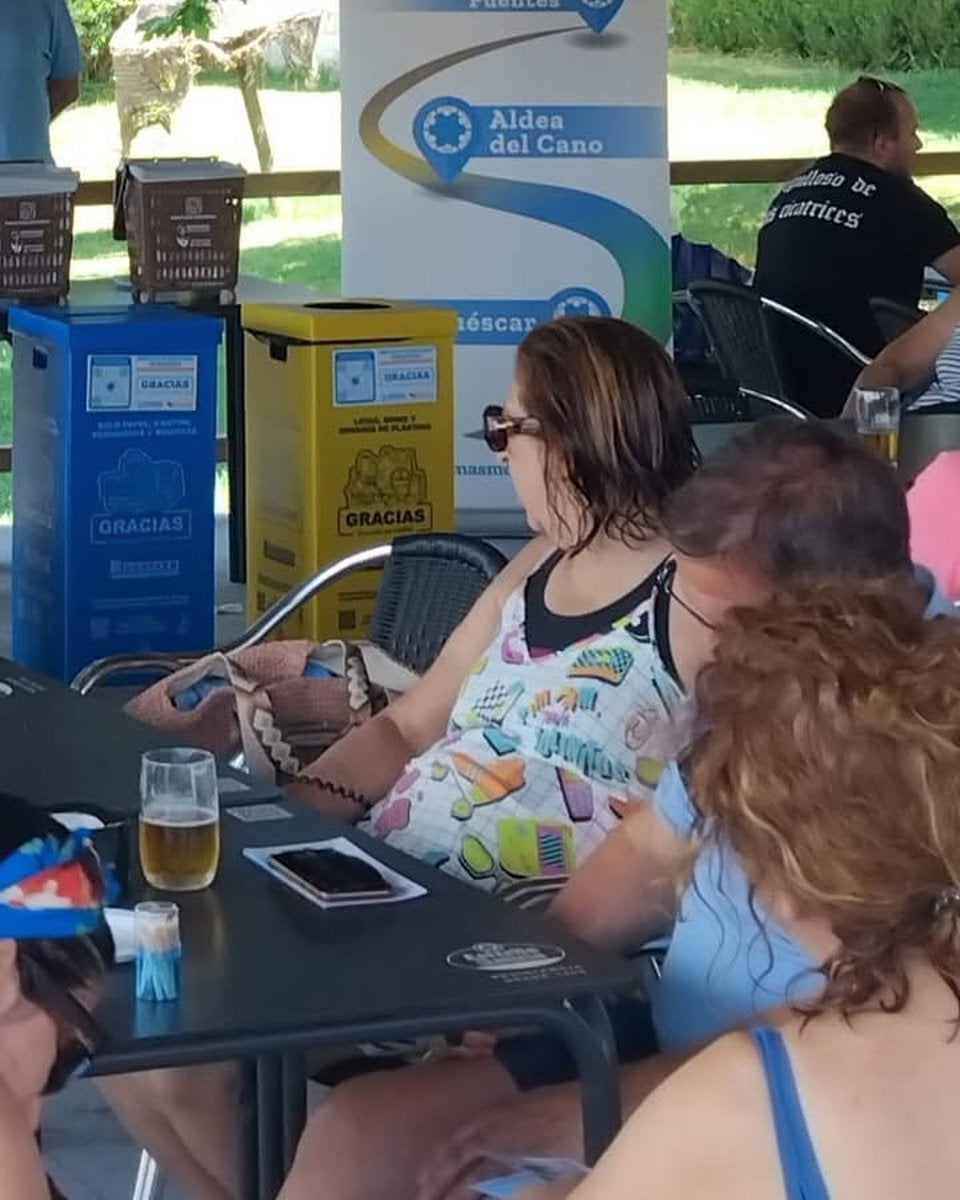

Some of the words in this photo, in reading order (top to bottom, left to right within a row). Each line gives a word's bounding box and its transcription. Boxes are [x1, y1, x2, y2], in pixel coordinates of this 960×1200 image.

[490, 109, 564, 129] Aldea
[490, 134, 529, 154] del
[537, 135, 603, 154] Cano
[98, 516, 184, 536] GRACIAS
[346, 509, 425, 527] GRACIAS
